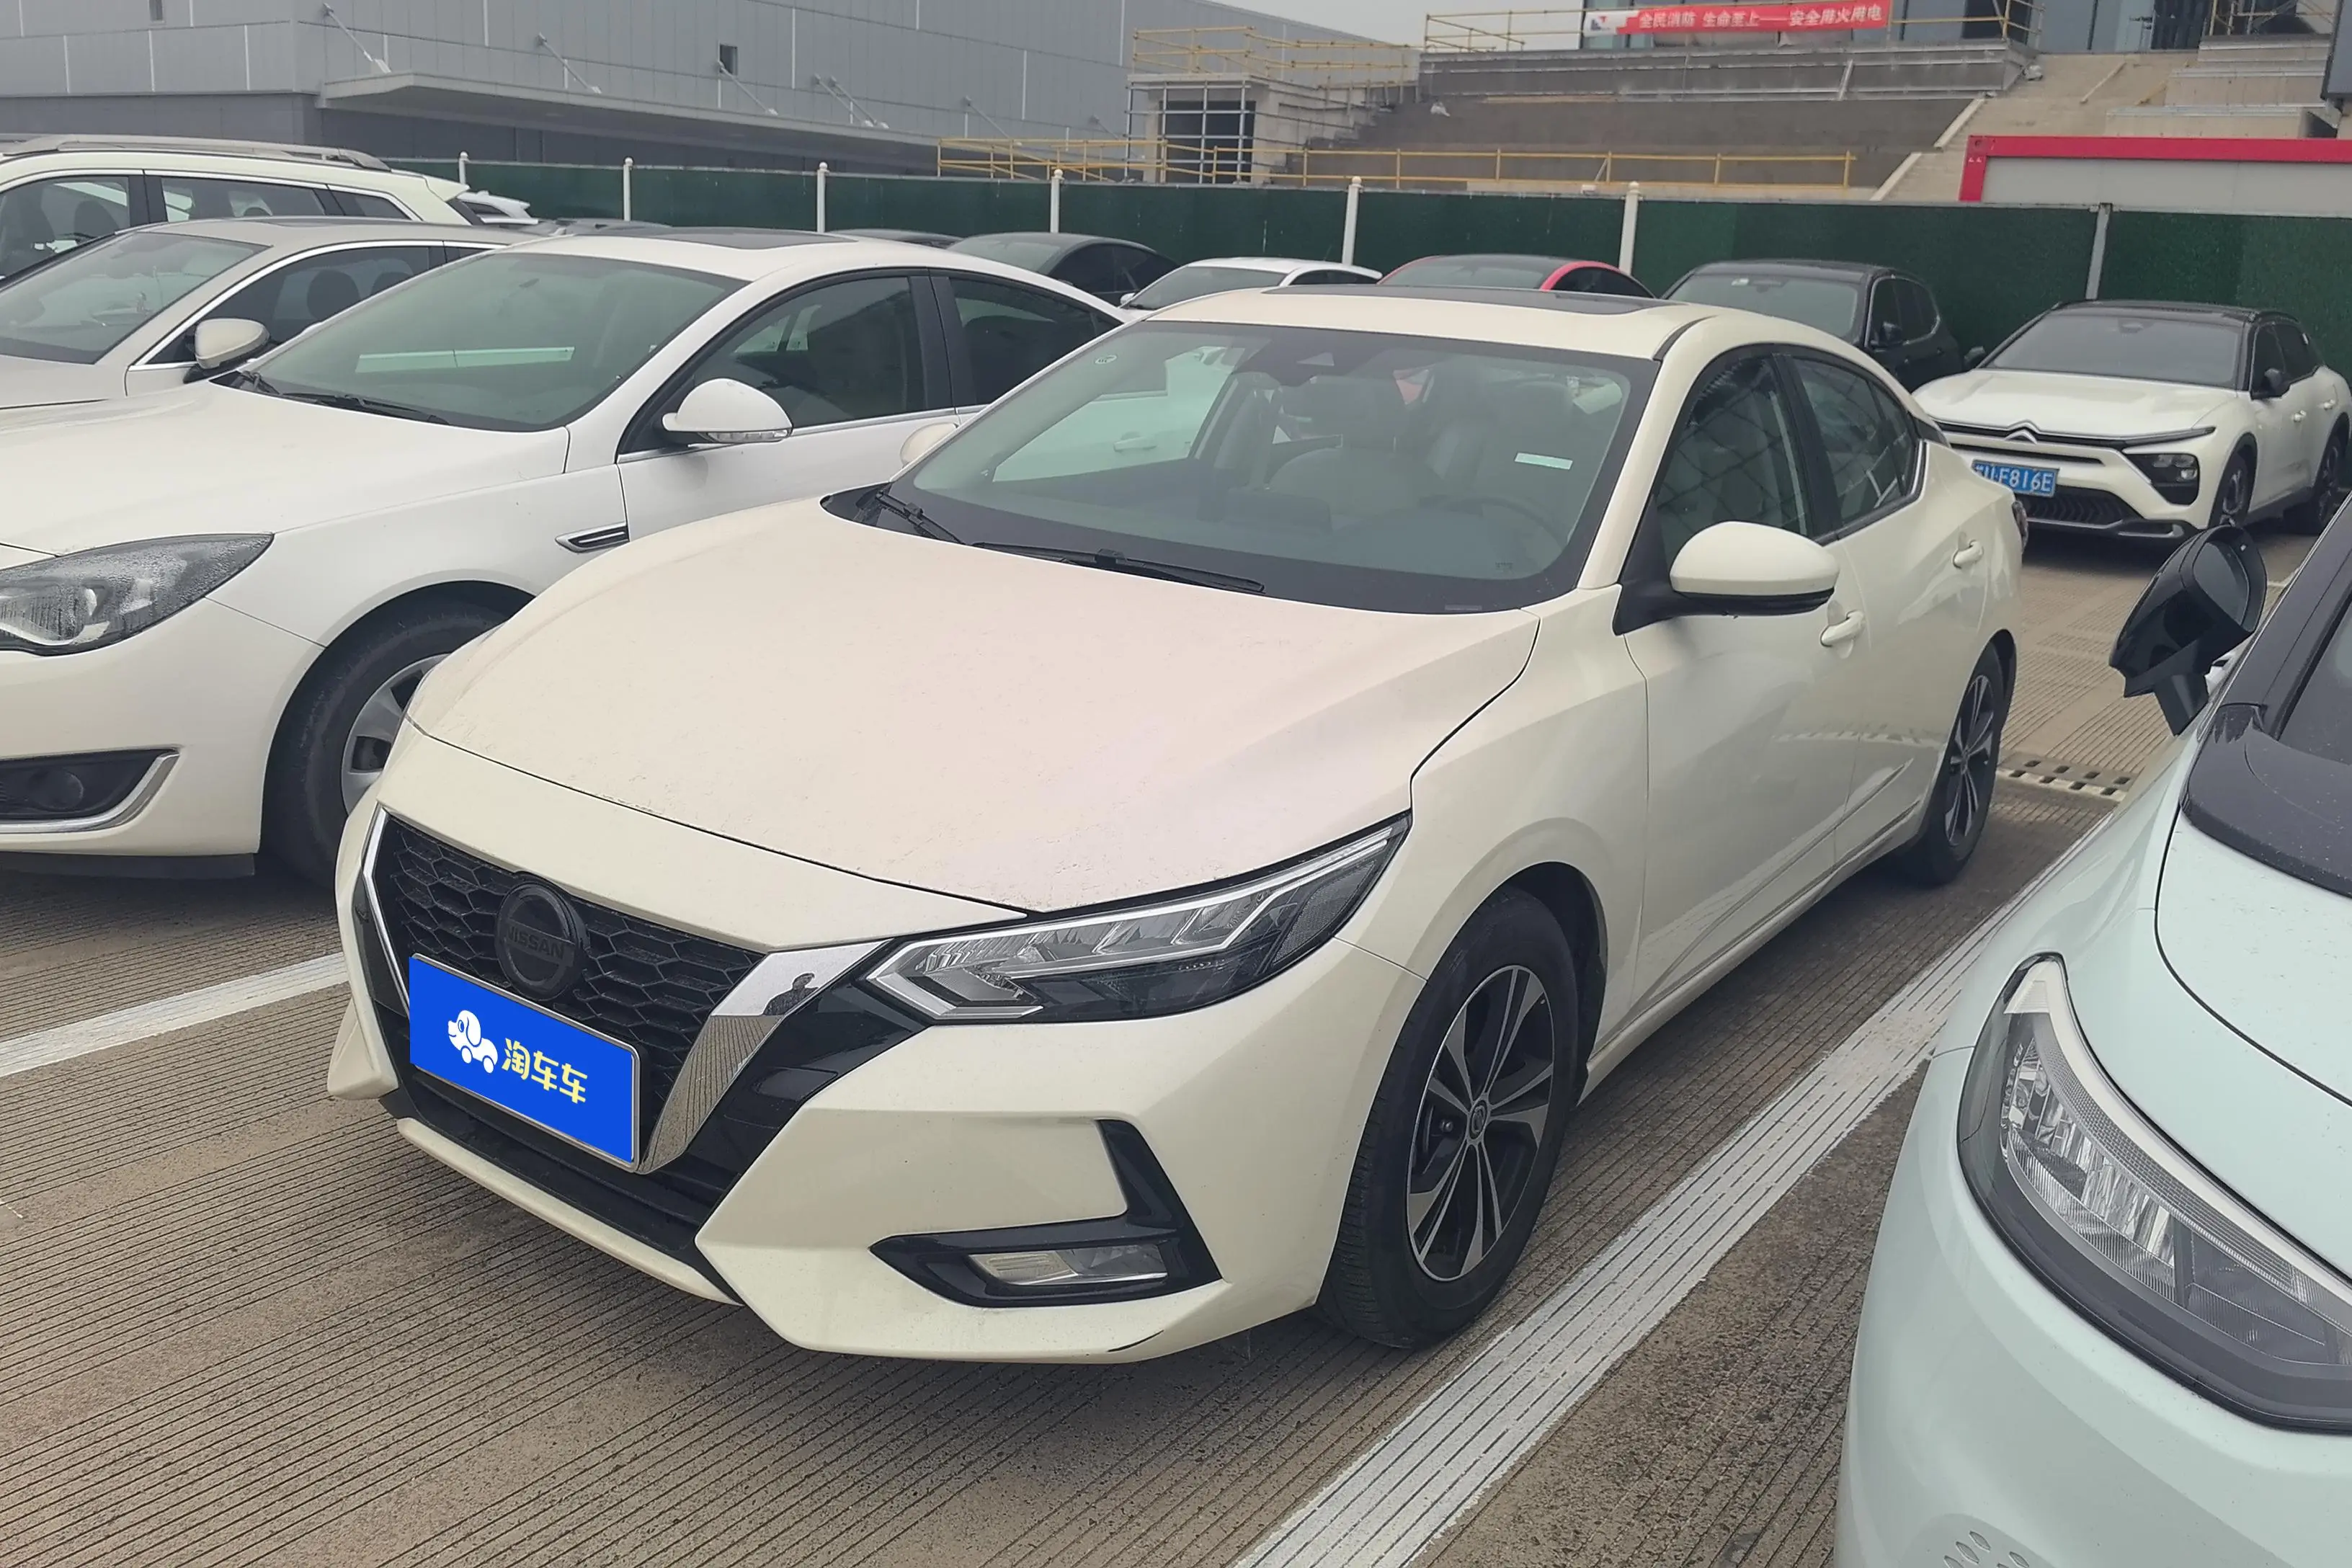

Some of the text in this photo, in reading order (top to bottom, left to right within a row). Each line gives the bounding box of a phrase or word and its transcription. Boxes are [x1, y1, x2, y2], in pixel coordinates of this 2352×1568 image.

[1639, 10, 1696, 28] 全民消防
[507, 924, 566, 960] NISSAN
